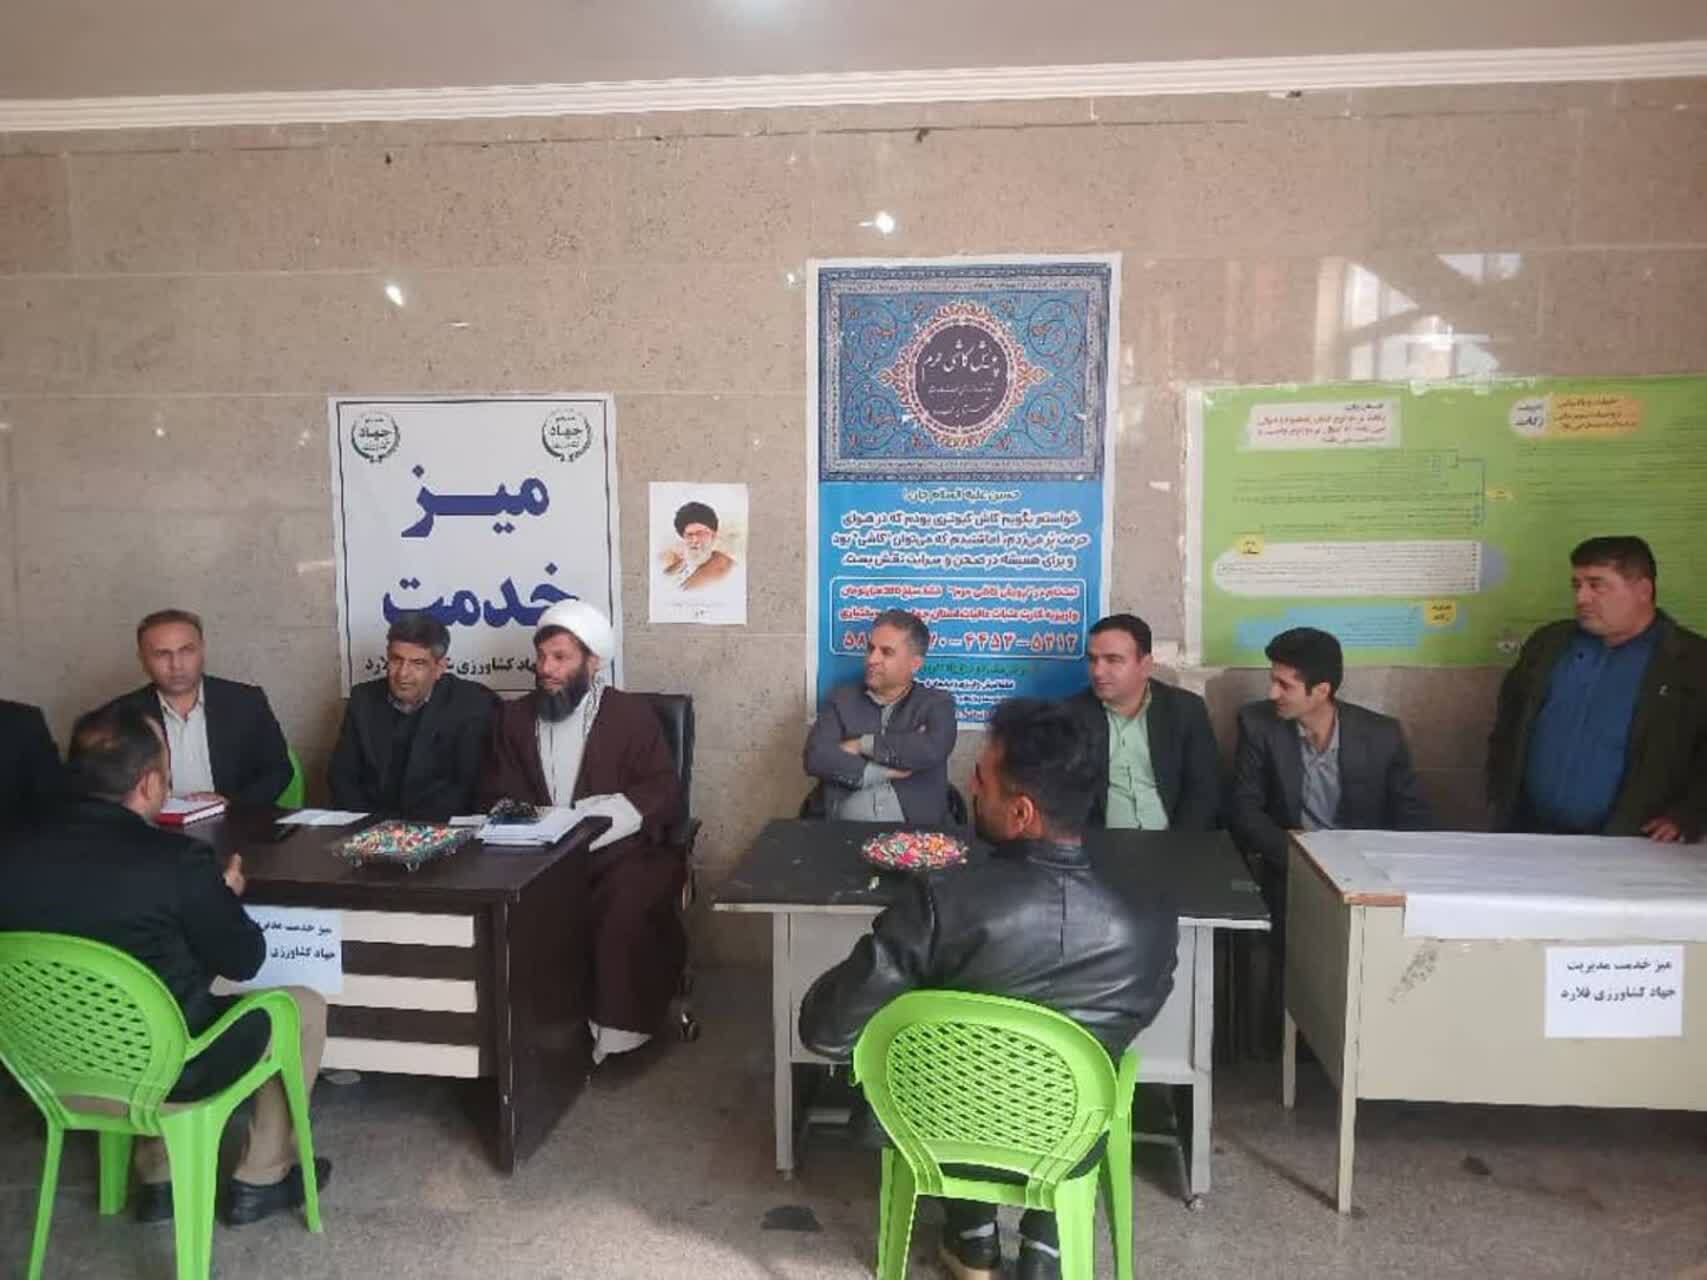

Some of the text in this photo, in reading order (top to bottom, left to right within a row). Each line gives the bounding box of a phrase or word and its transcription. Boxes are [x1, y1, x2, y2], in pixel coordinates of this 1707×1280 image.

[550, 425, 583, 440] جهاد
[400, 464, 550, 539] میز
[1001, 508, 1035, 528] بگویم
[1036, 510, 1080, 528] خواستم
[382, 561, 580, 628] خدمت
[456, 656, 515, 676] کشاورزی
[1593, 985, 1645, 1002] کشاورزی
[1649, 985, 1677, 1000] جهاد
